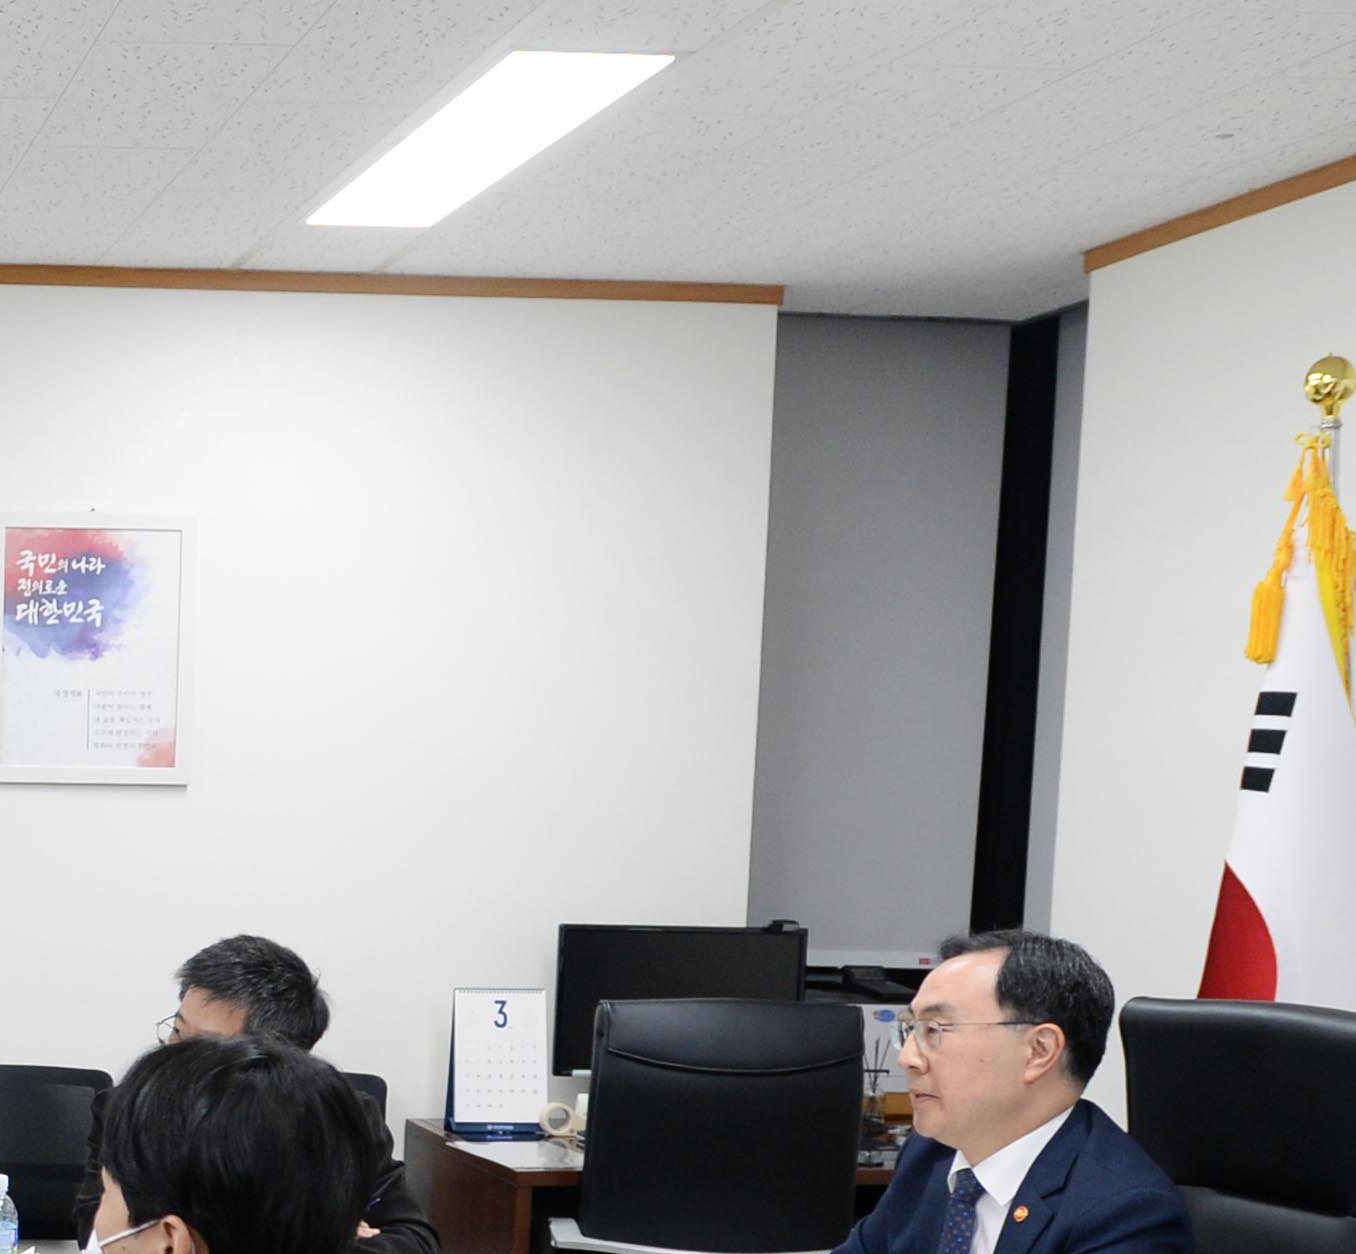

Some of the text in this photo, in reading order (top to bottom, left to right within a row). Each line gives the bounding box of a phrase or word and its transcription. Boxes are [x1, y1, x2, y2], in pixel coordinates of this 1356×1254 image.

[16, 549, 106, 577] 국민의 나라
[17, 577, 68, 597] 정의로운
[15, 598, 105, 628] 대한민국
[494, 1000, 508, 1028] 3
